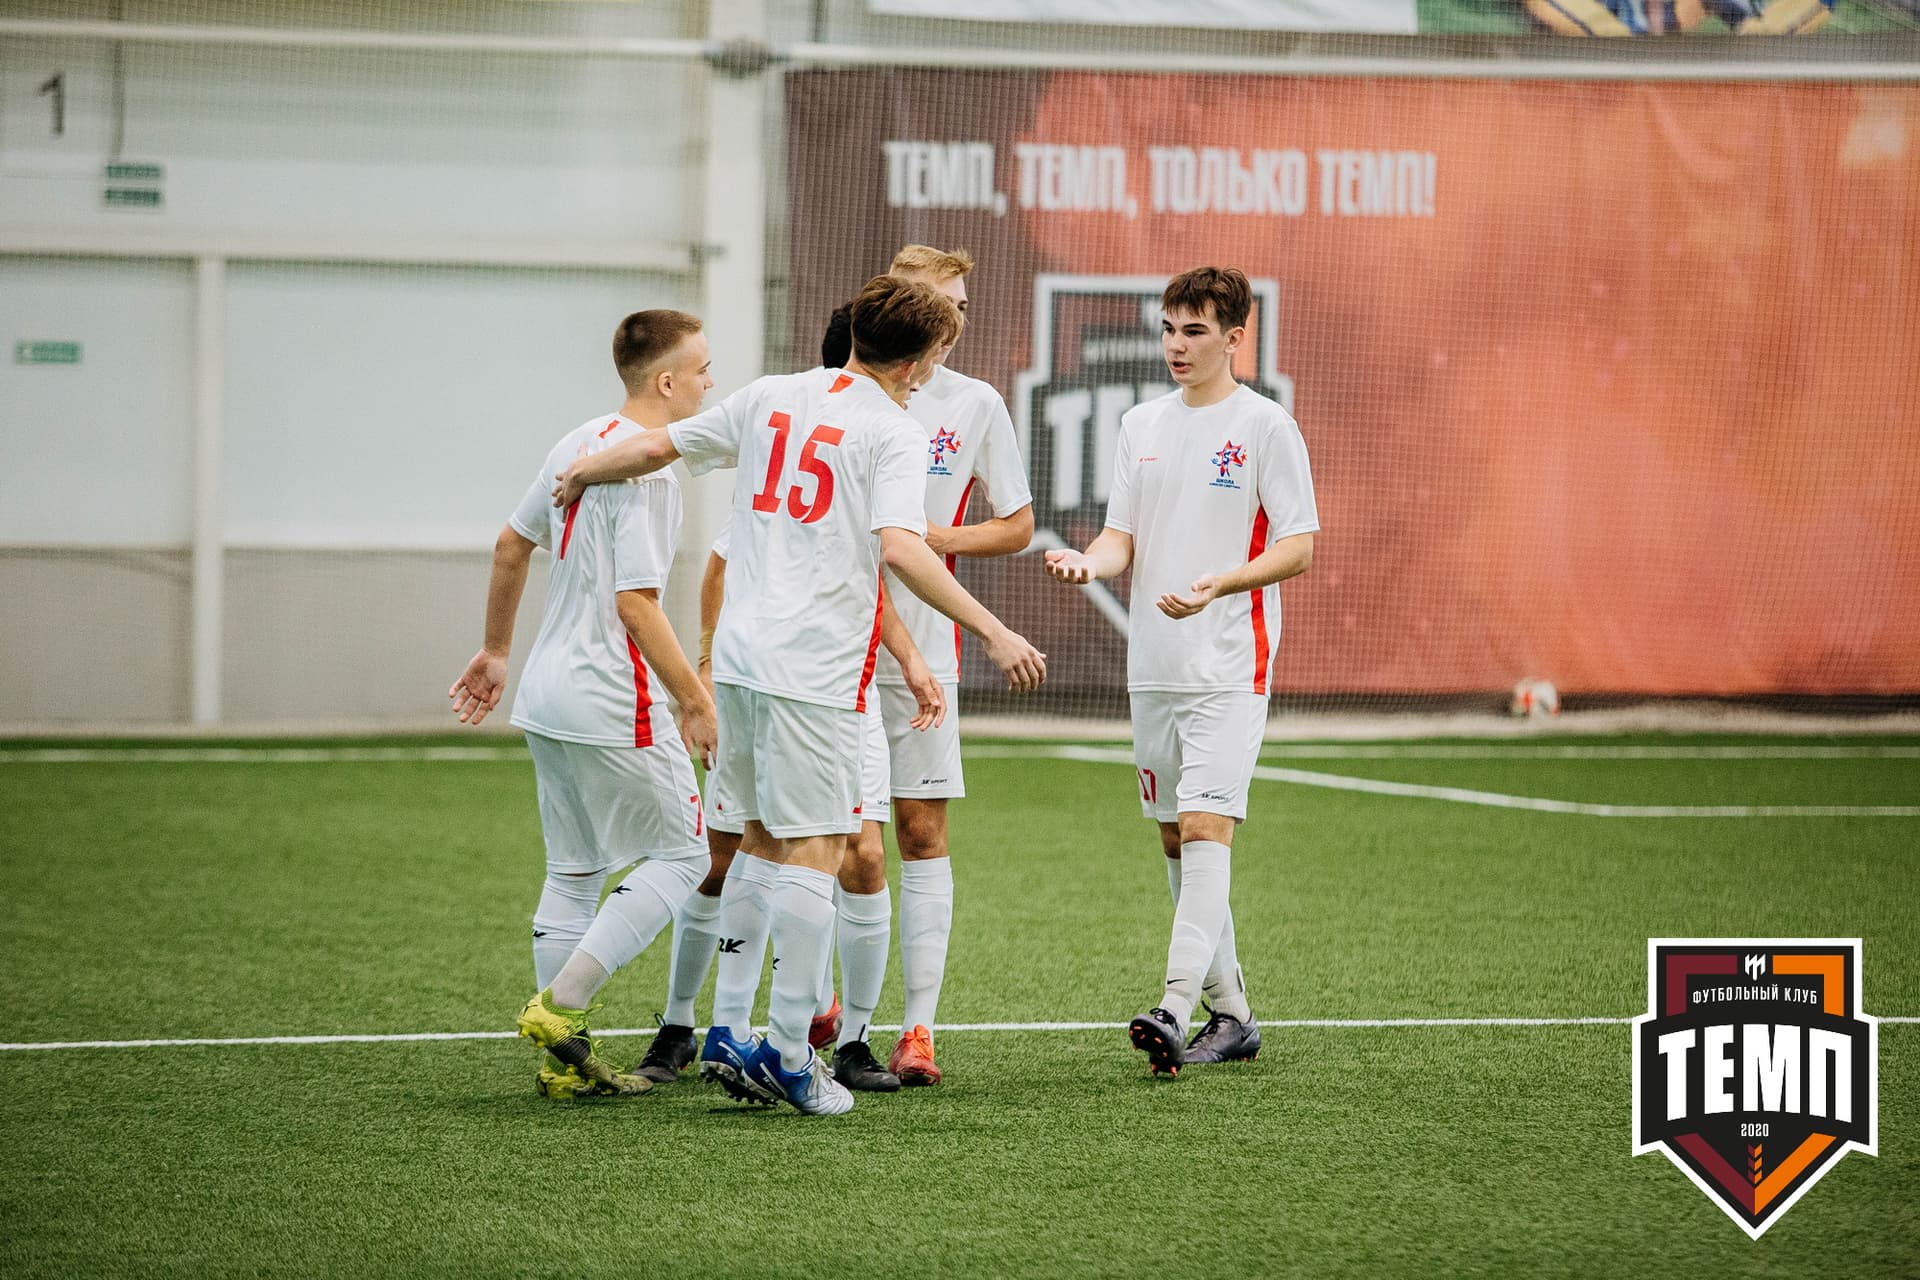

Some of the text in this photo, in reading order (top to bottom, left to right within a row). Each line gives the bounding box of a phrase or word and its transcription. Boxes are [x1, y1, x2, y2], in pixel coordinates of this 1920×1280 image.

[38, 72, 65, 136] 1
[884, 141, 1436, 220] ТЕМП, ТЕМП, ТОЛЬКО ТЕМП!
[752, 411, 845, 524] 15
